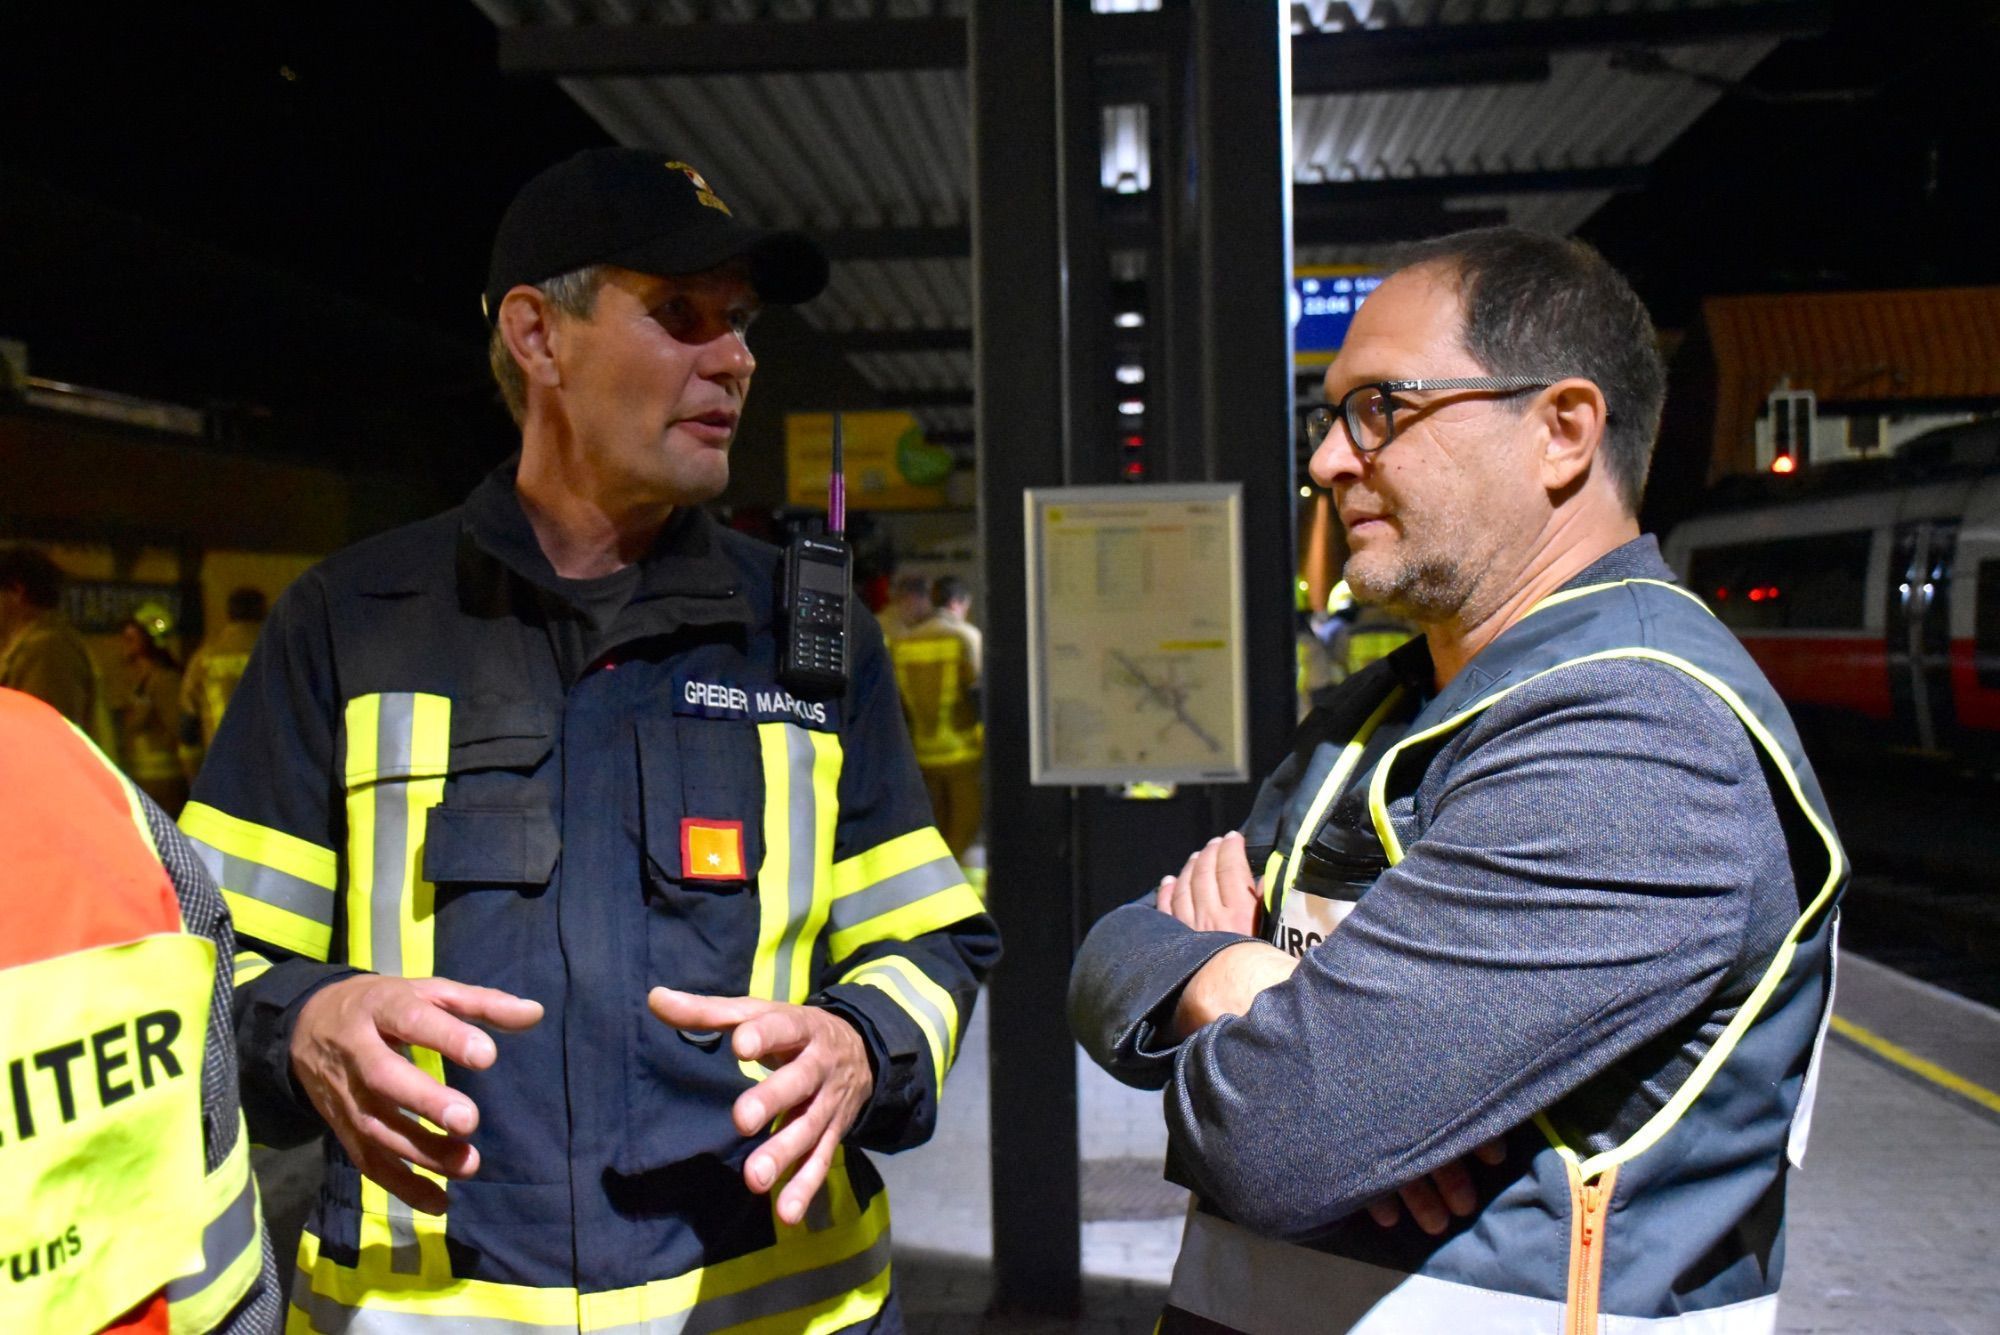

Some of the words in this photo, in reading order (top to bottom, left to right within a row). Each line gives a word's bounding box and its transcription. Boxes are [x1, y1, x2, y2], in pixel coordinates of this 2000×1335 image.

[684, 681, 749, 712] GREBER
[757, 692, 826, 723] MARKUS
[0, 1009, 183, 1147] ITER
[0, 1224, 82, 1283] uns
